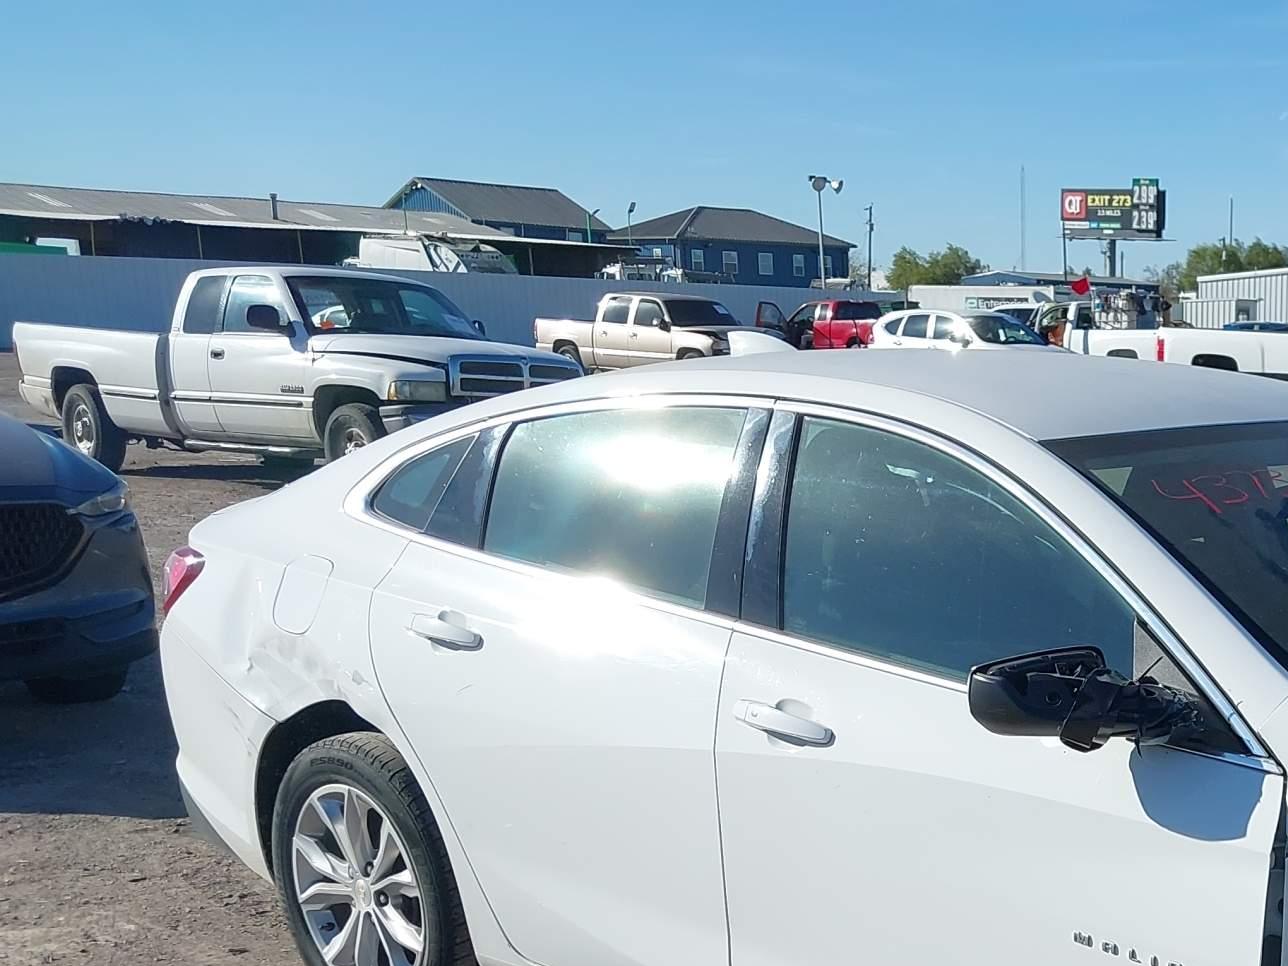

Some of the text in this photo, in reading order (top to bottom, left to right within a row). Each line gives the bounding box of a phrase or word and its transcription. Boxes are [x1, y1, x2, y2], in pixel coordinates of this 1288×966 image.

[1065, 195, 1082, 215] QT
[1087, 194, 1132, 207] EXIT 273
